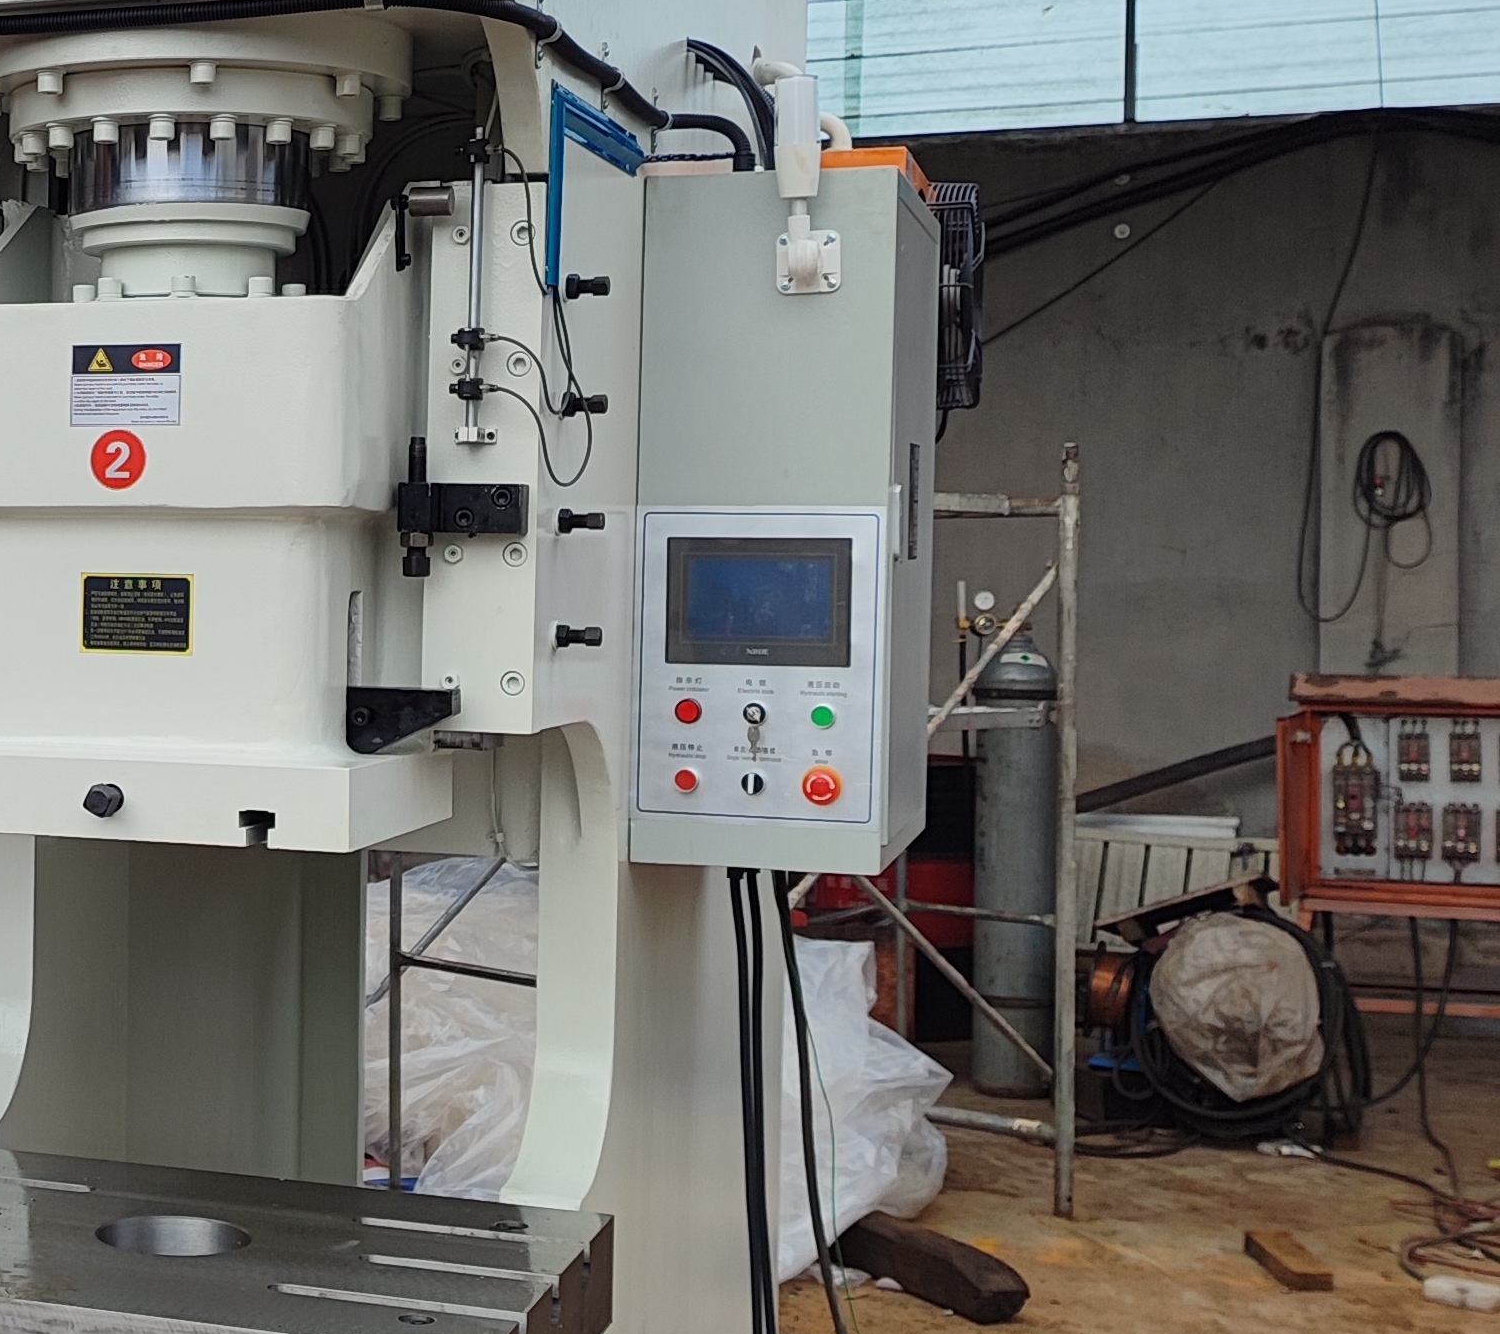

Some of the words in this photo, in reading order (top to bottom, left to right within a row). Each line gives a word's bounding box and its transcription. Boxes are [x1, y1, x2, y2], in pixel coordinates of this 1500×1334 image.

[104, 440, 131, 479] 2
[109, 579, 163, 590] 注意事项
